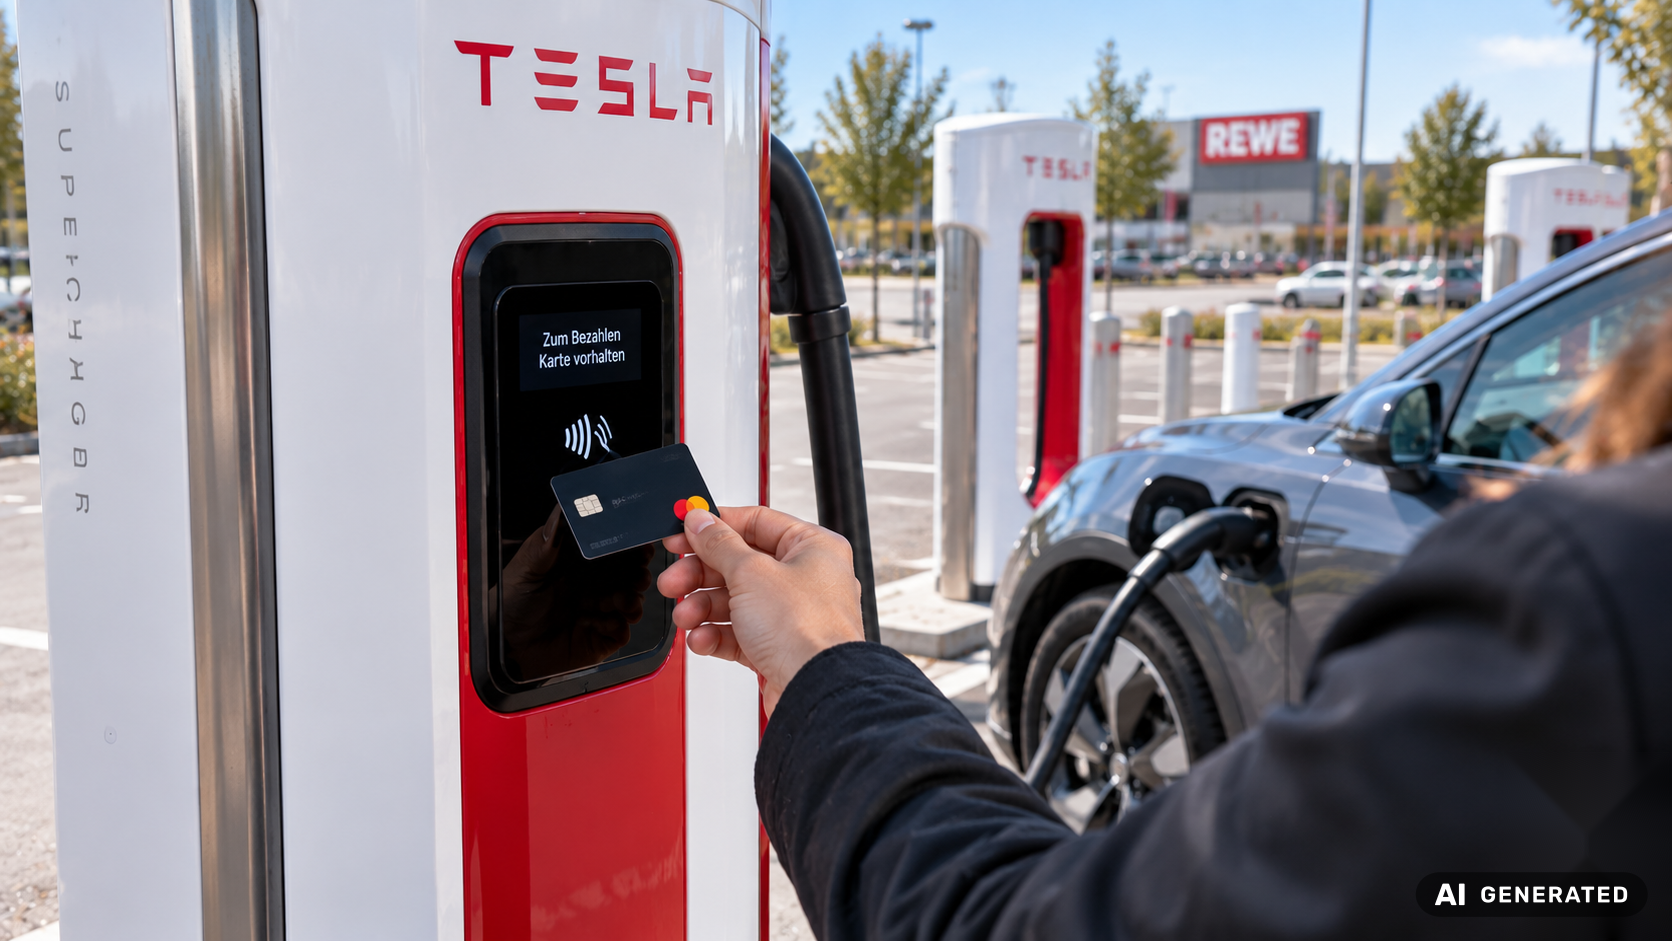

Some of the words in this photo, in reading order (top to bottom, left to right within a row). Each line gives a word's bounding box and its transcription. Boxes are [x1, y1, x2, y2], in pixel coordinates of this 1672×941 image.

[454, 40, 713, 125] TESLA
[1205, 117, 1301, 158] REWE
[543, 332, 568, 347] Zum
[571, 327, 621, 345] Bezahlen
[539, 353, 571, 369] Karte
[573, 348, 625, 365] vorhalten
